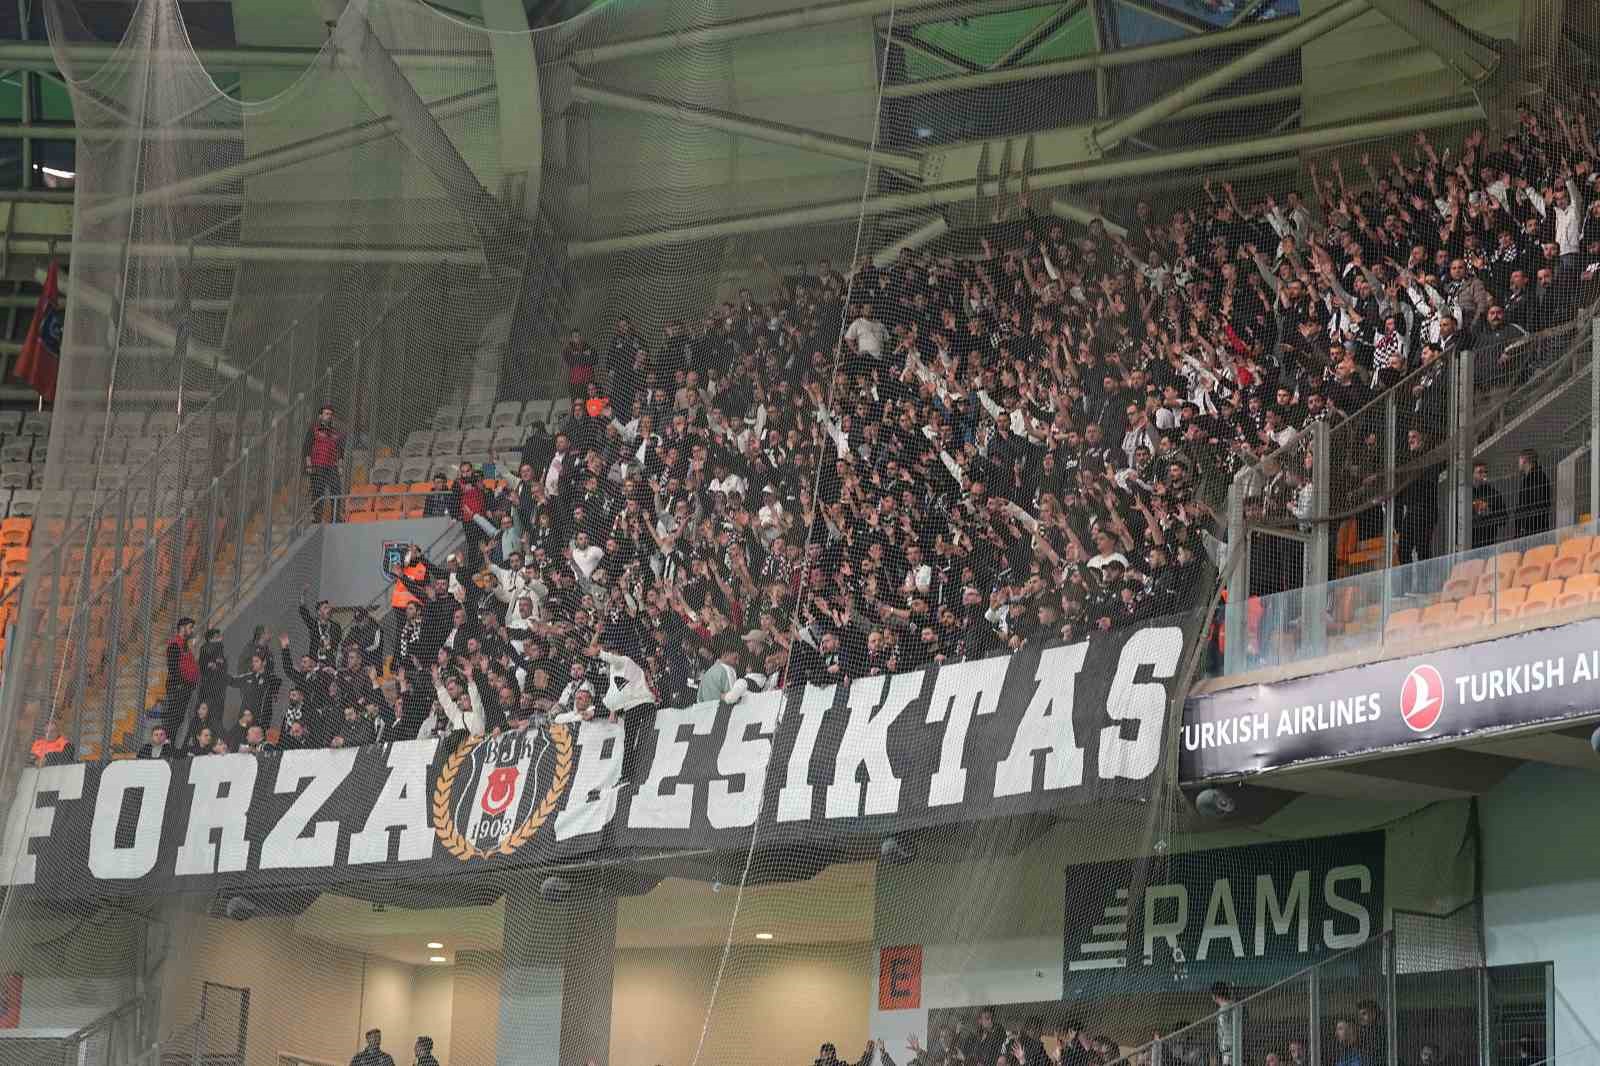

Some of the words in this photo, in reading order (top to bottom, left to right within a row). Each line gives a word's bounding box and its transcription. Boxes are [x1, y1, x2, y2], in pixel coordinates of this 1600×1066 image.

[1456, 656, 1565, 705] TURKISH
[1180, 713, 1269, 751] URKISH
[1276, 692, 1381, 737] AIRLINES
[486, 735, 534, 763] BJK
[0, 738, 439, 886] FORZA
[472, 819, 513, 840] 1903
[1143, 864, 1371, 966] RAMS
[890, 958, 912, 998] E
